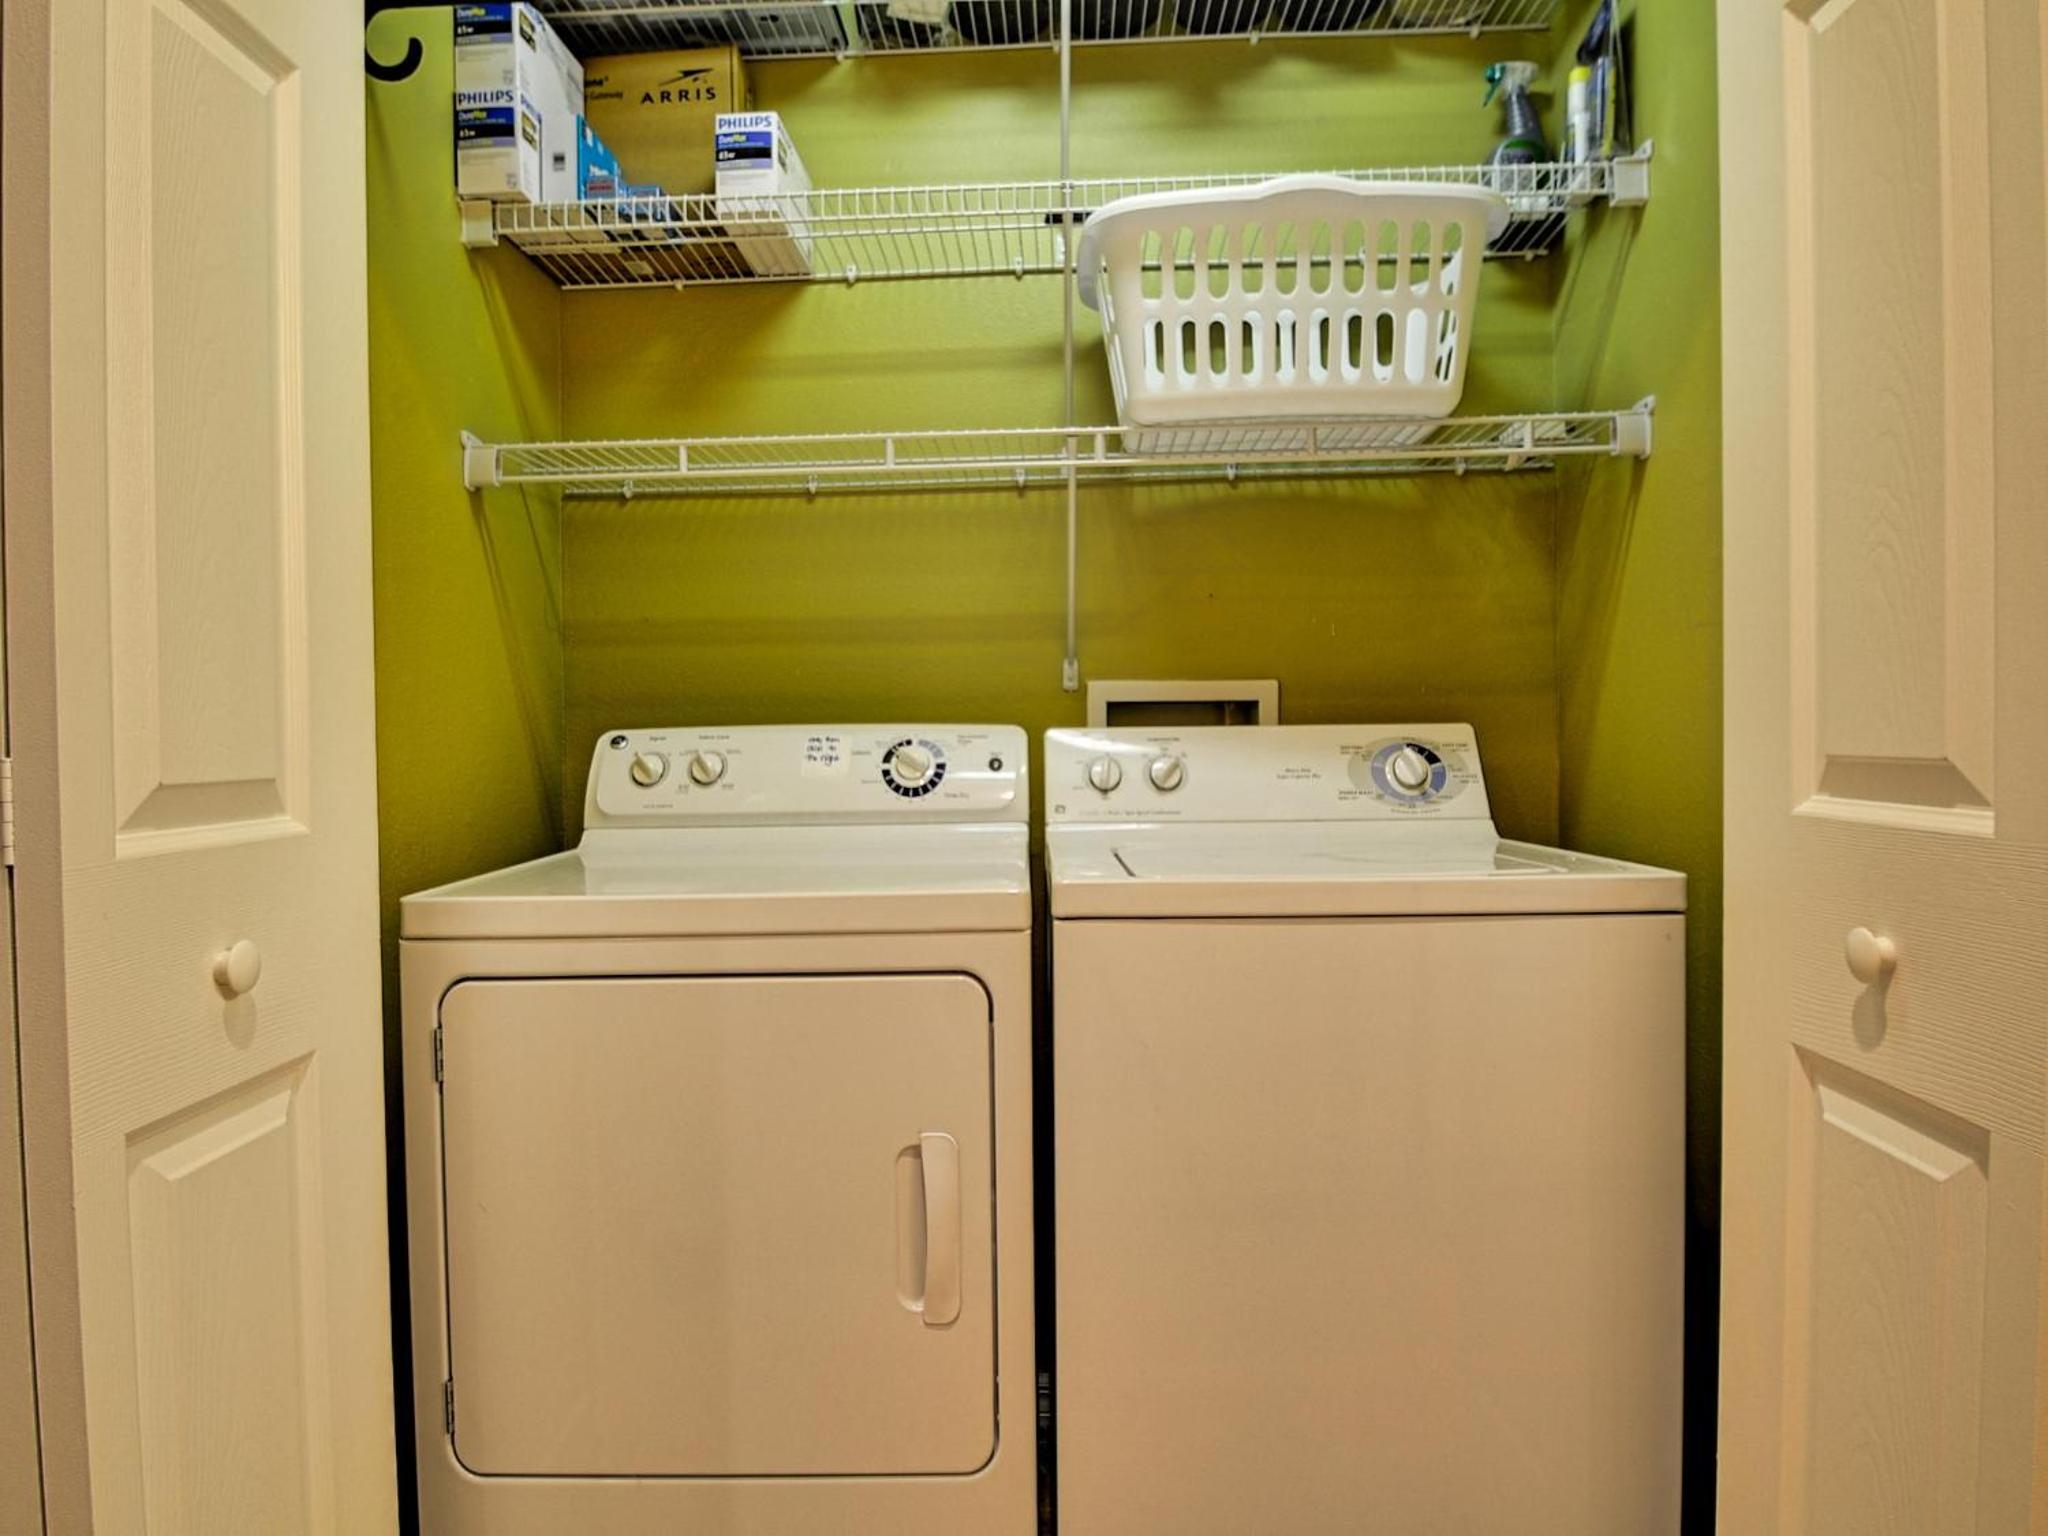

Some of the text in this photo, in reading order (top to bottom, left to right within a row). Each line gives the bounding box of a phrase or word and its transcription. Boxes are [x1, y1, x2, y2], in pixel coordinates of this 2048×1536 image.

[457, 90, 514, 105] PHILIPS
[641, 87, 717, 104] ARRIS
[718, 115, 773, 130] PHILIPS
